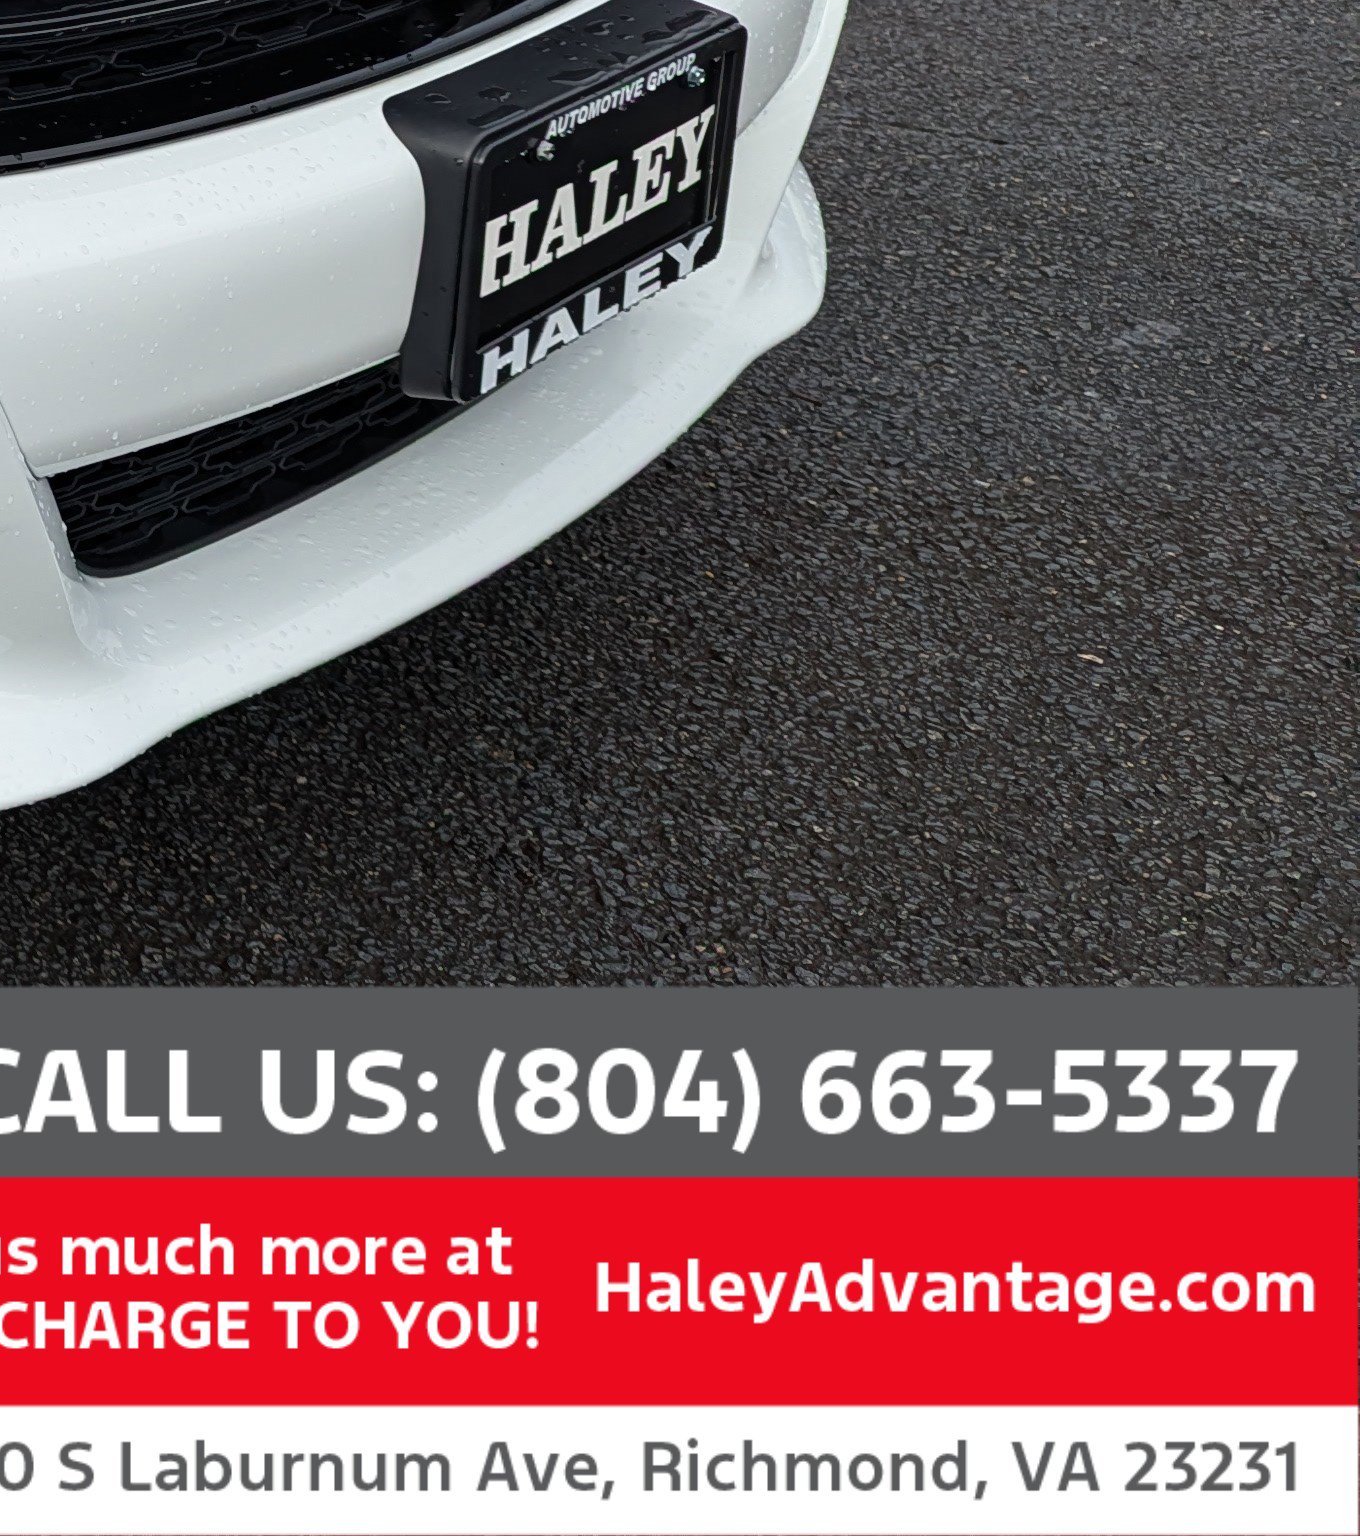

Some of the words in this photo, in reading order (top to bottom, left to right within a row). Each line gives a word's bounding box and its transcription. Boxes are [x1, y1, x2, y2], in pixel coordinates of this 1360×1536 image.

[545, 77, 644, 140] AUTOMOTIVE
[646, 53, 697, 92] GROUP
[480, 104, 715, 299] HALEY
[480, 226, 714, 395] HALEY
